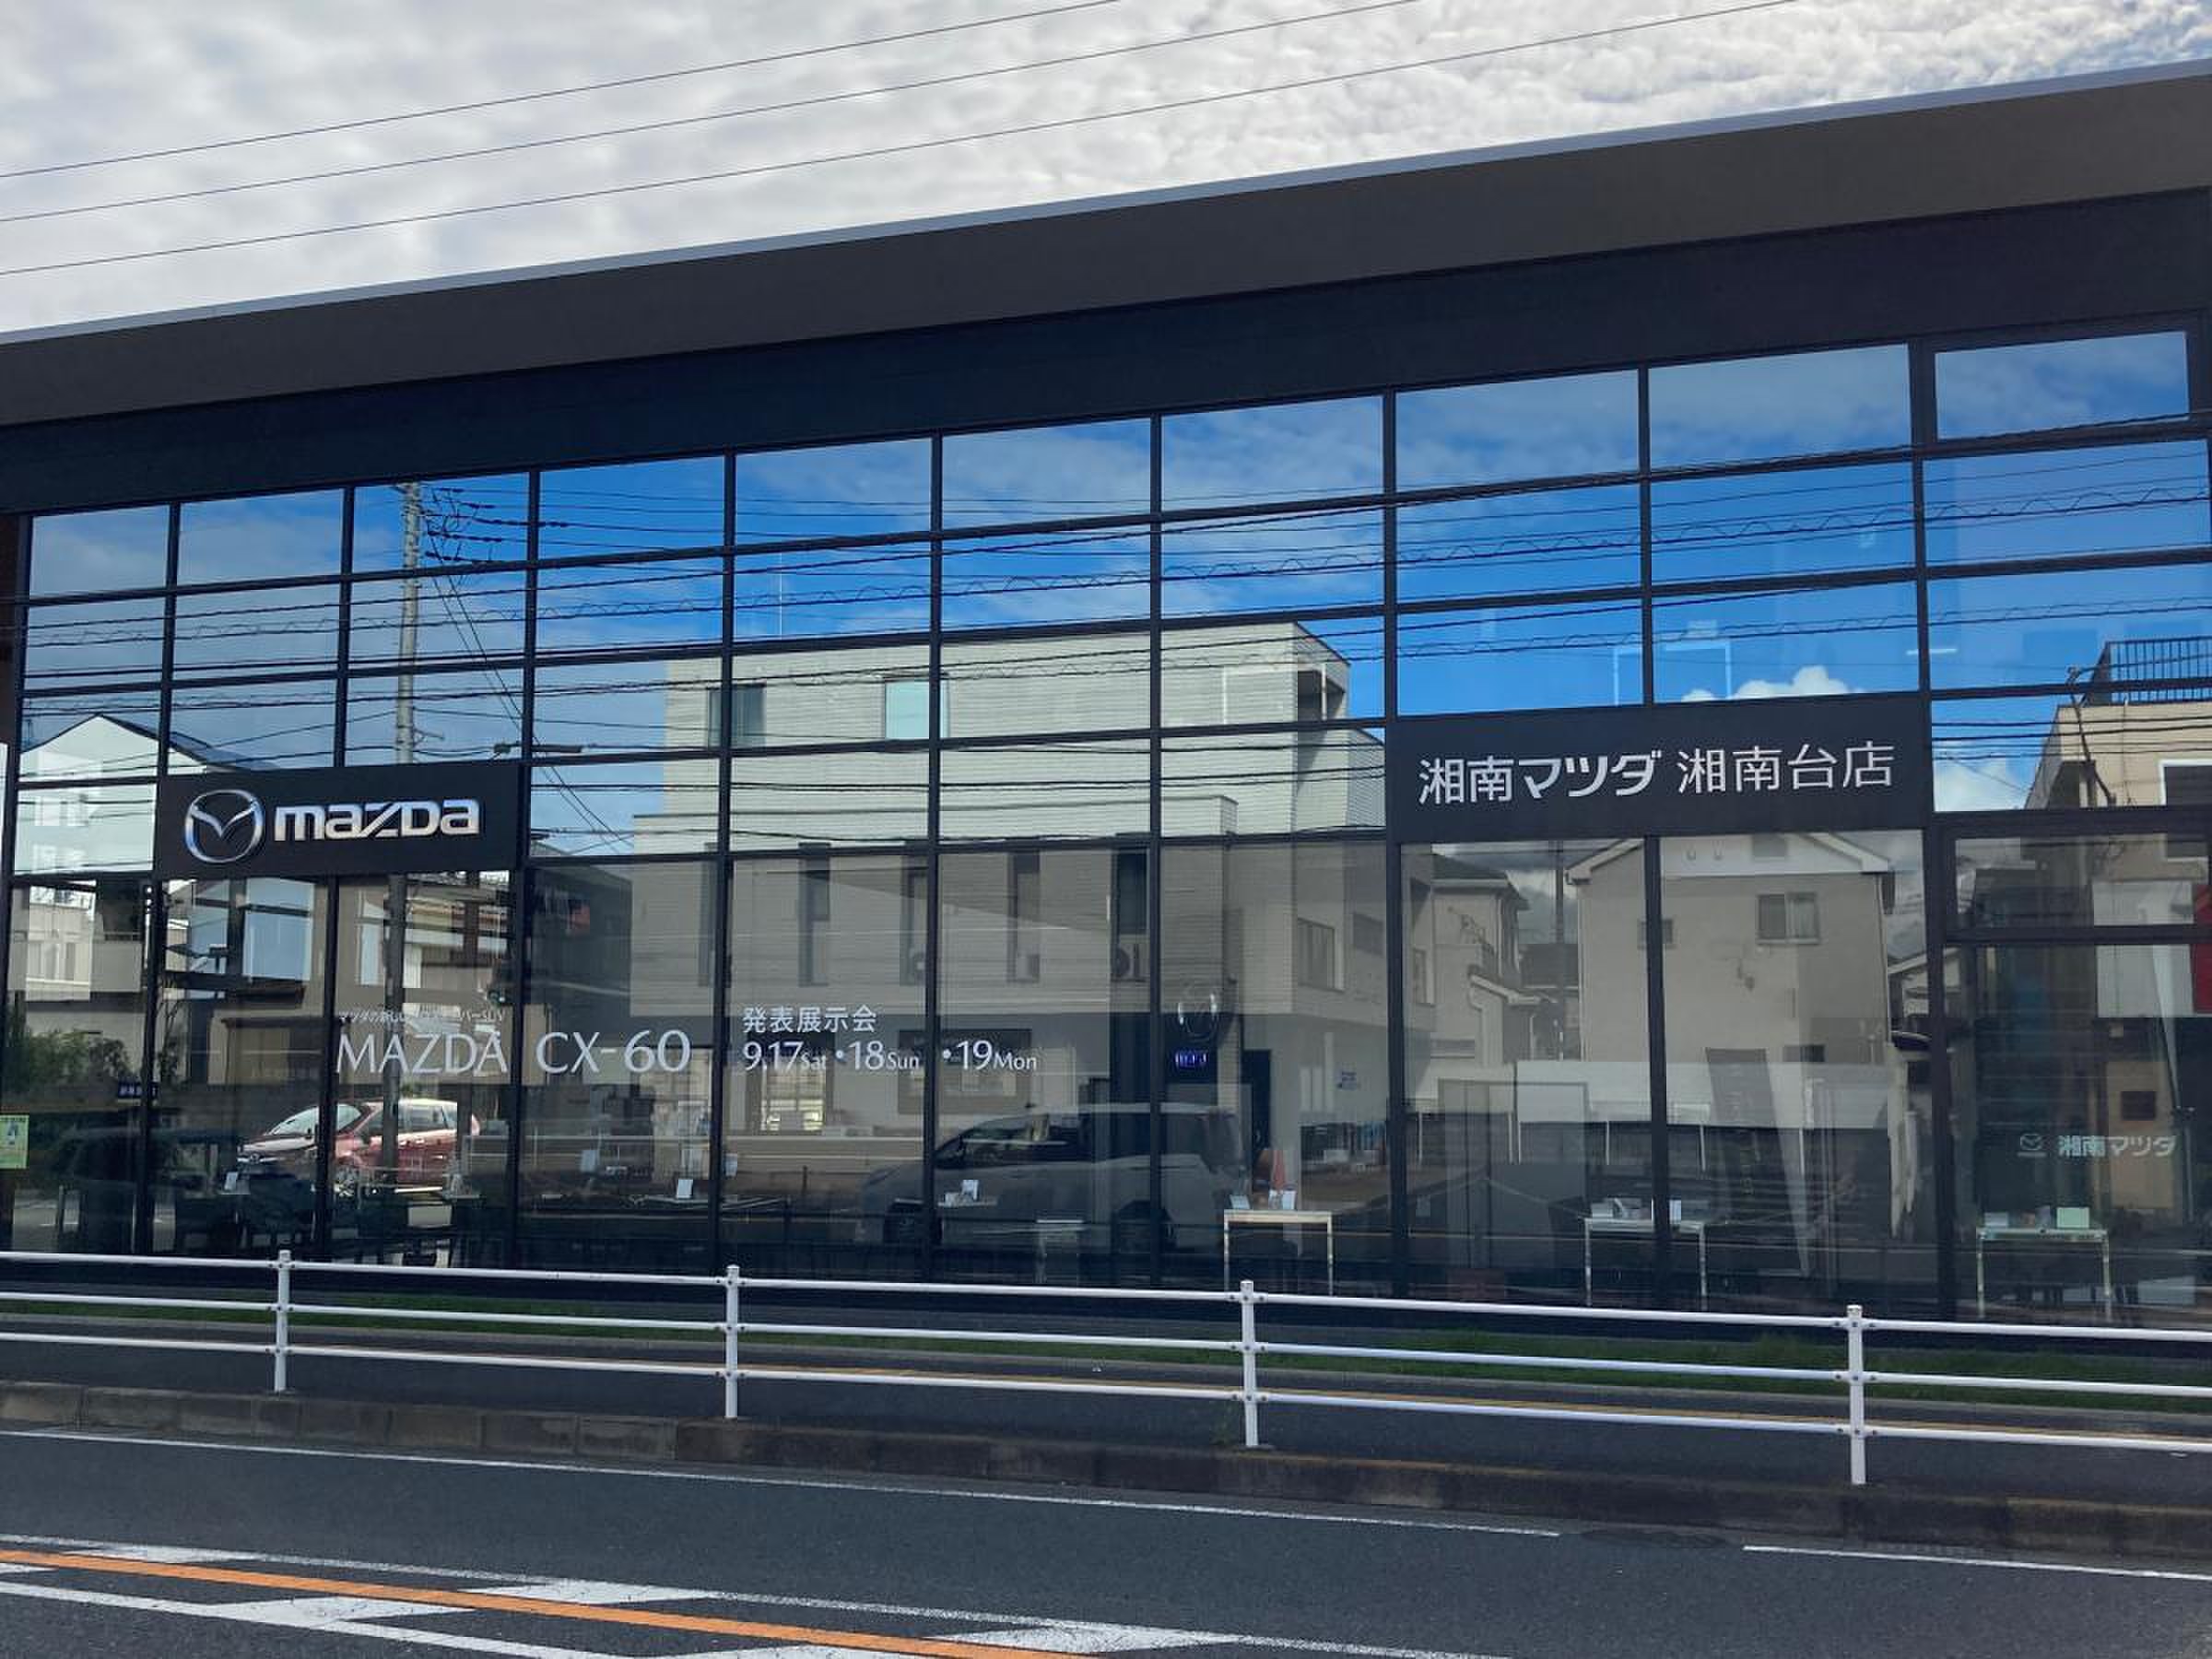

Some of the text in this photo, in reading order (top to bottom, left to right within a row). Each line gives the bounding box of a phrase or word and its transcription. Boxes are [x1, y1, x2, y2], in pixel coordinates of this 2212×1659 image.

[1418, 740, 1895, 805] 湘南マツダ 湘南台店
[742, 1005, 877, 1033] 発表展示会
[336, 1029, 691, 1075] MAZDA CX-60
[2057, 1135, 2177, 1158] 湘南マツダ
